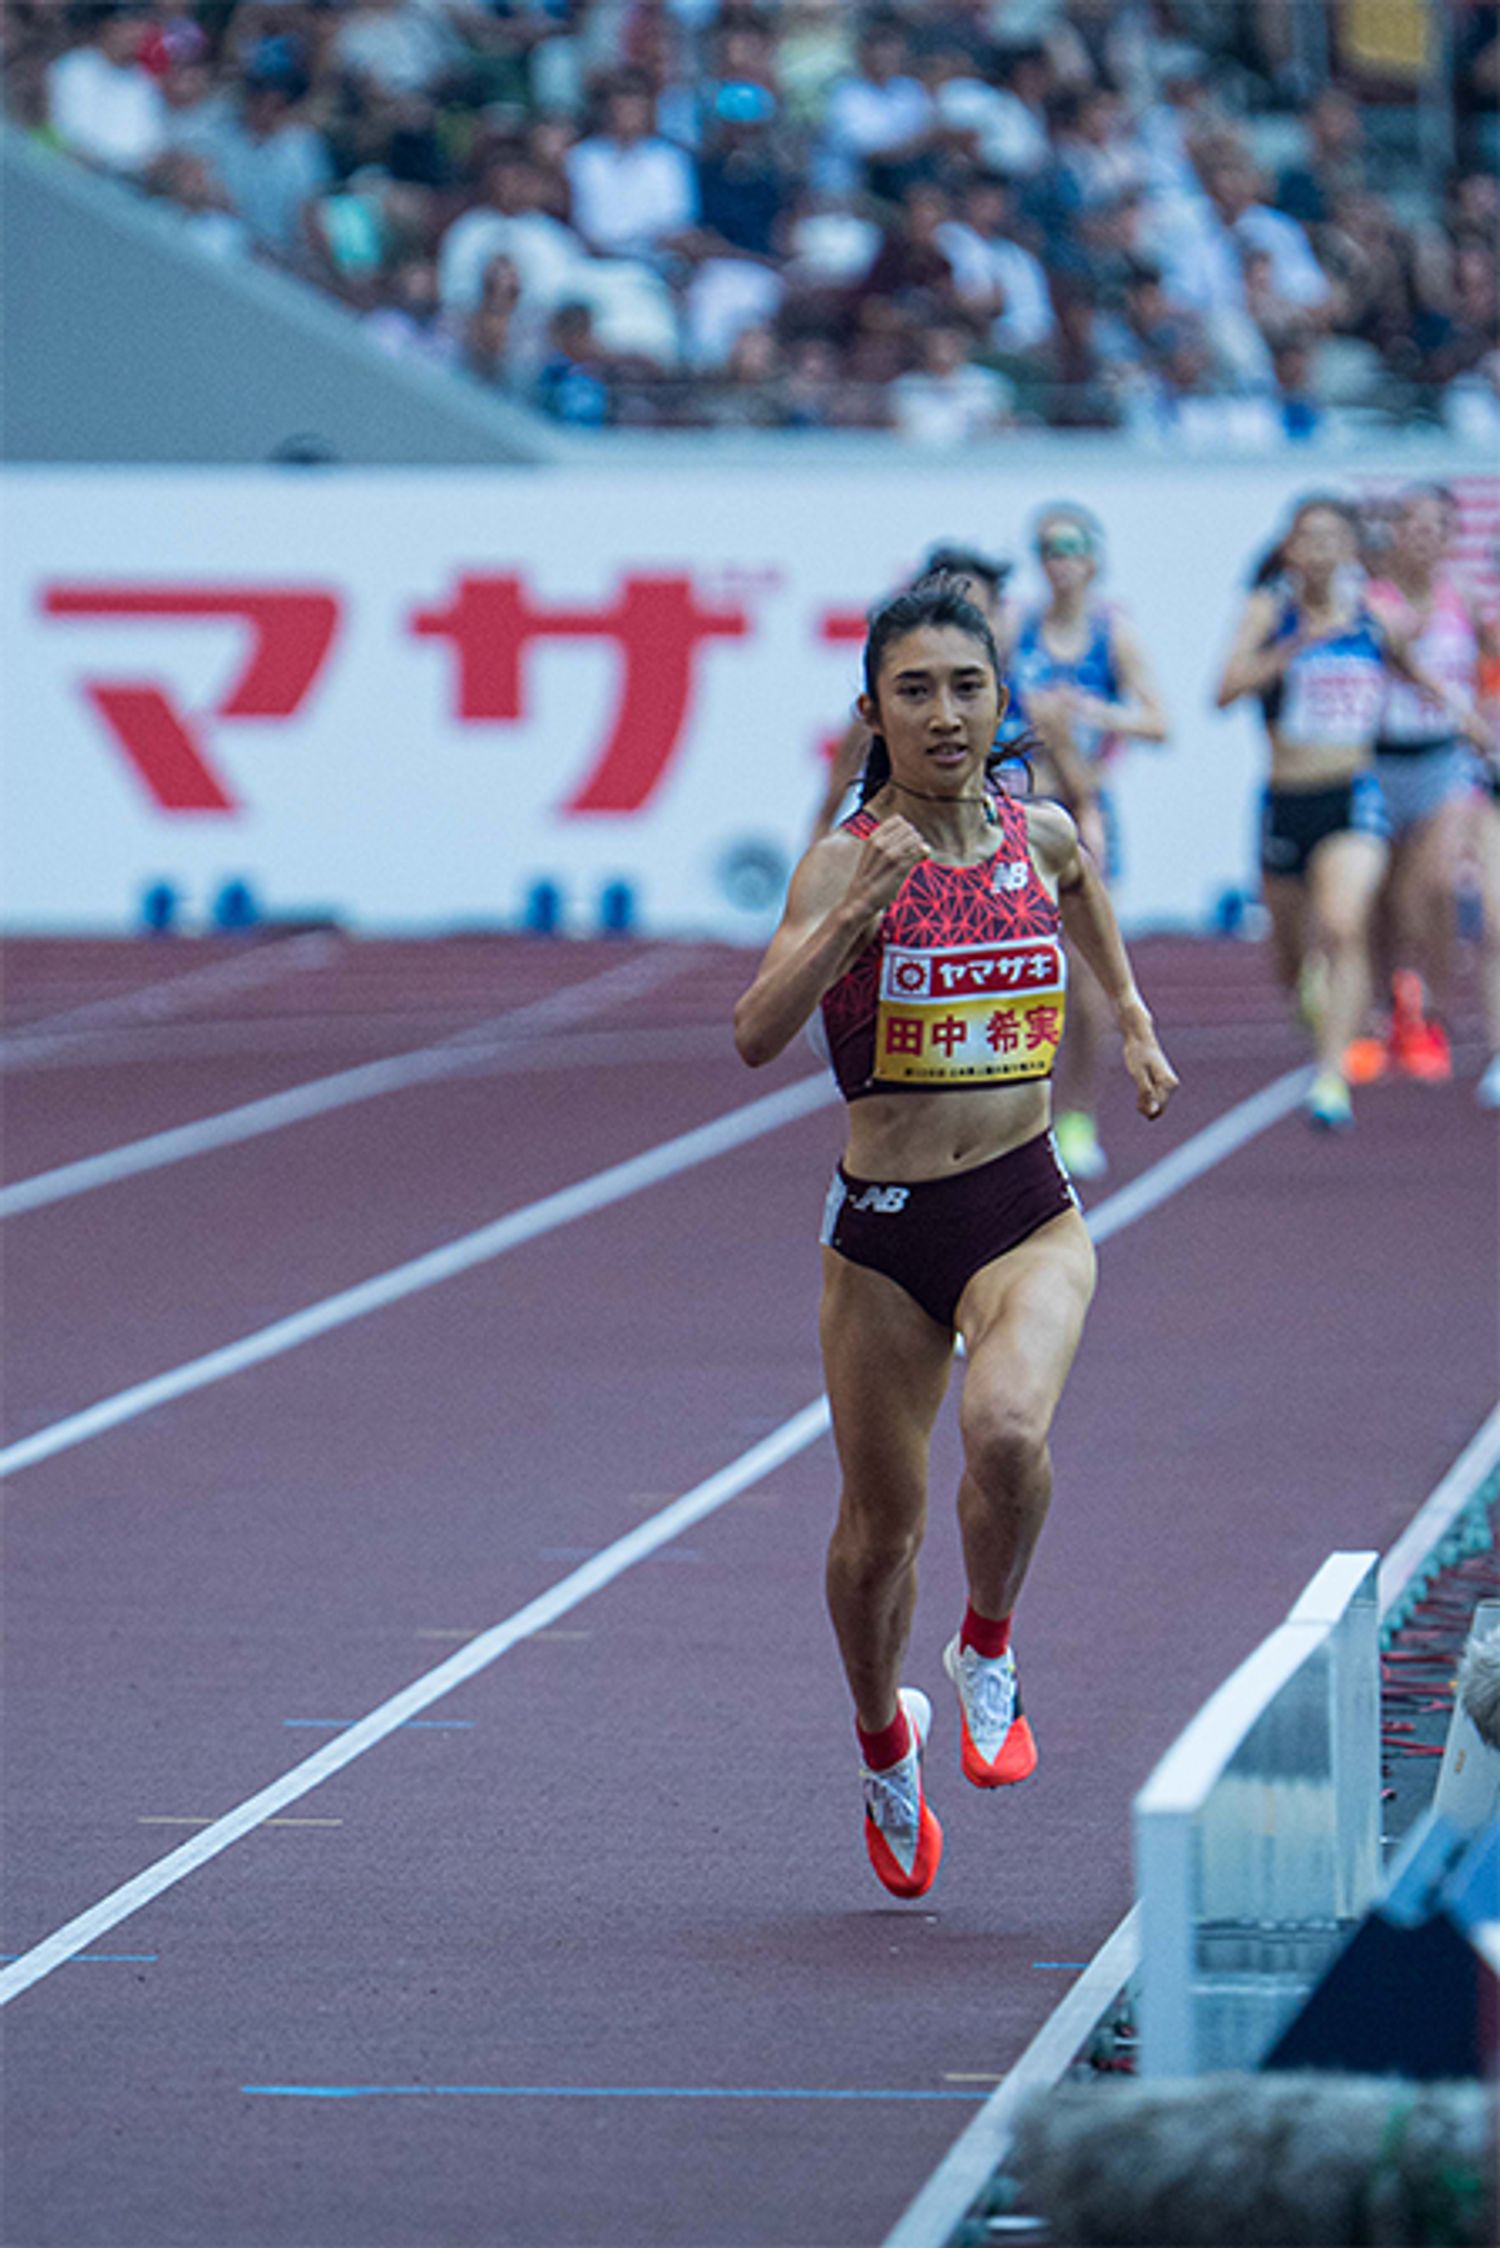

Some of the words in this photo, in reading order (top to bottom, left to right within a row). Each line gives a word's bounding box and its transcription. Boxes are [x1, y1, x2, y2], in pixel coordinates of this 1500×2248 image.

[42, 570, 868, 814] マザ
[991, 861, 1028, 894] NB
[938, 953, 1053, 988] ヤマザキ
[886, 1013, 967, 1058] 田中
[986, 1004, 1061, 1056] 希実
[852, 1185, 911, 1214] NB
